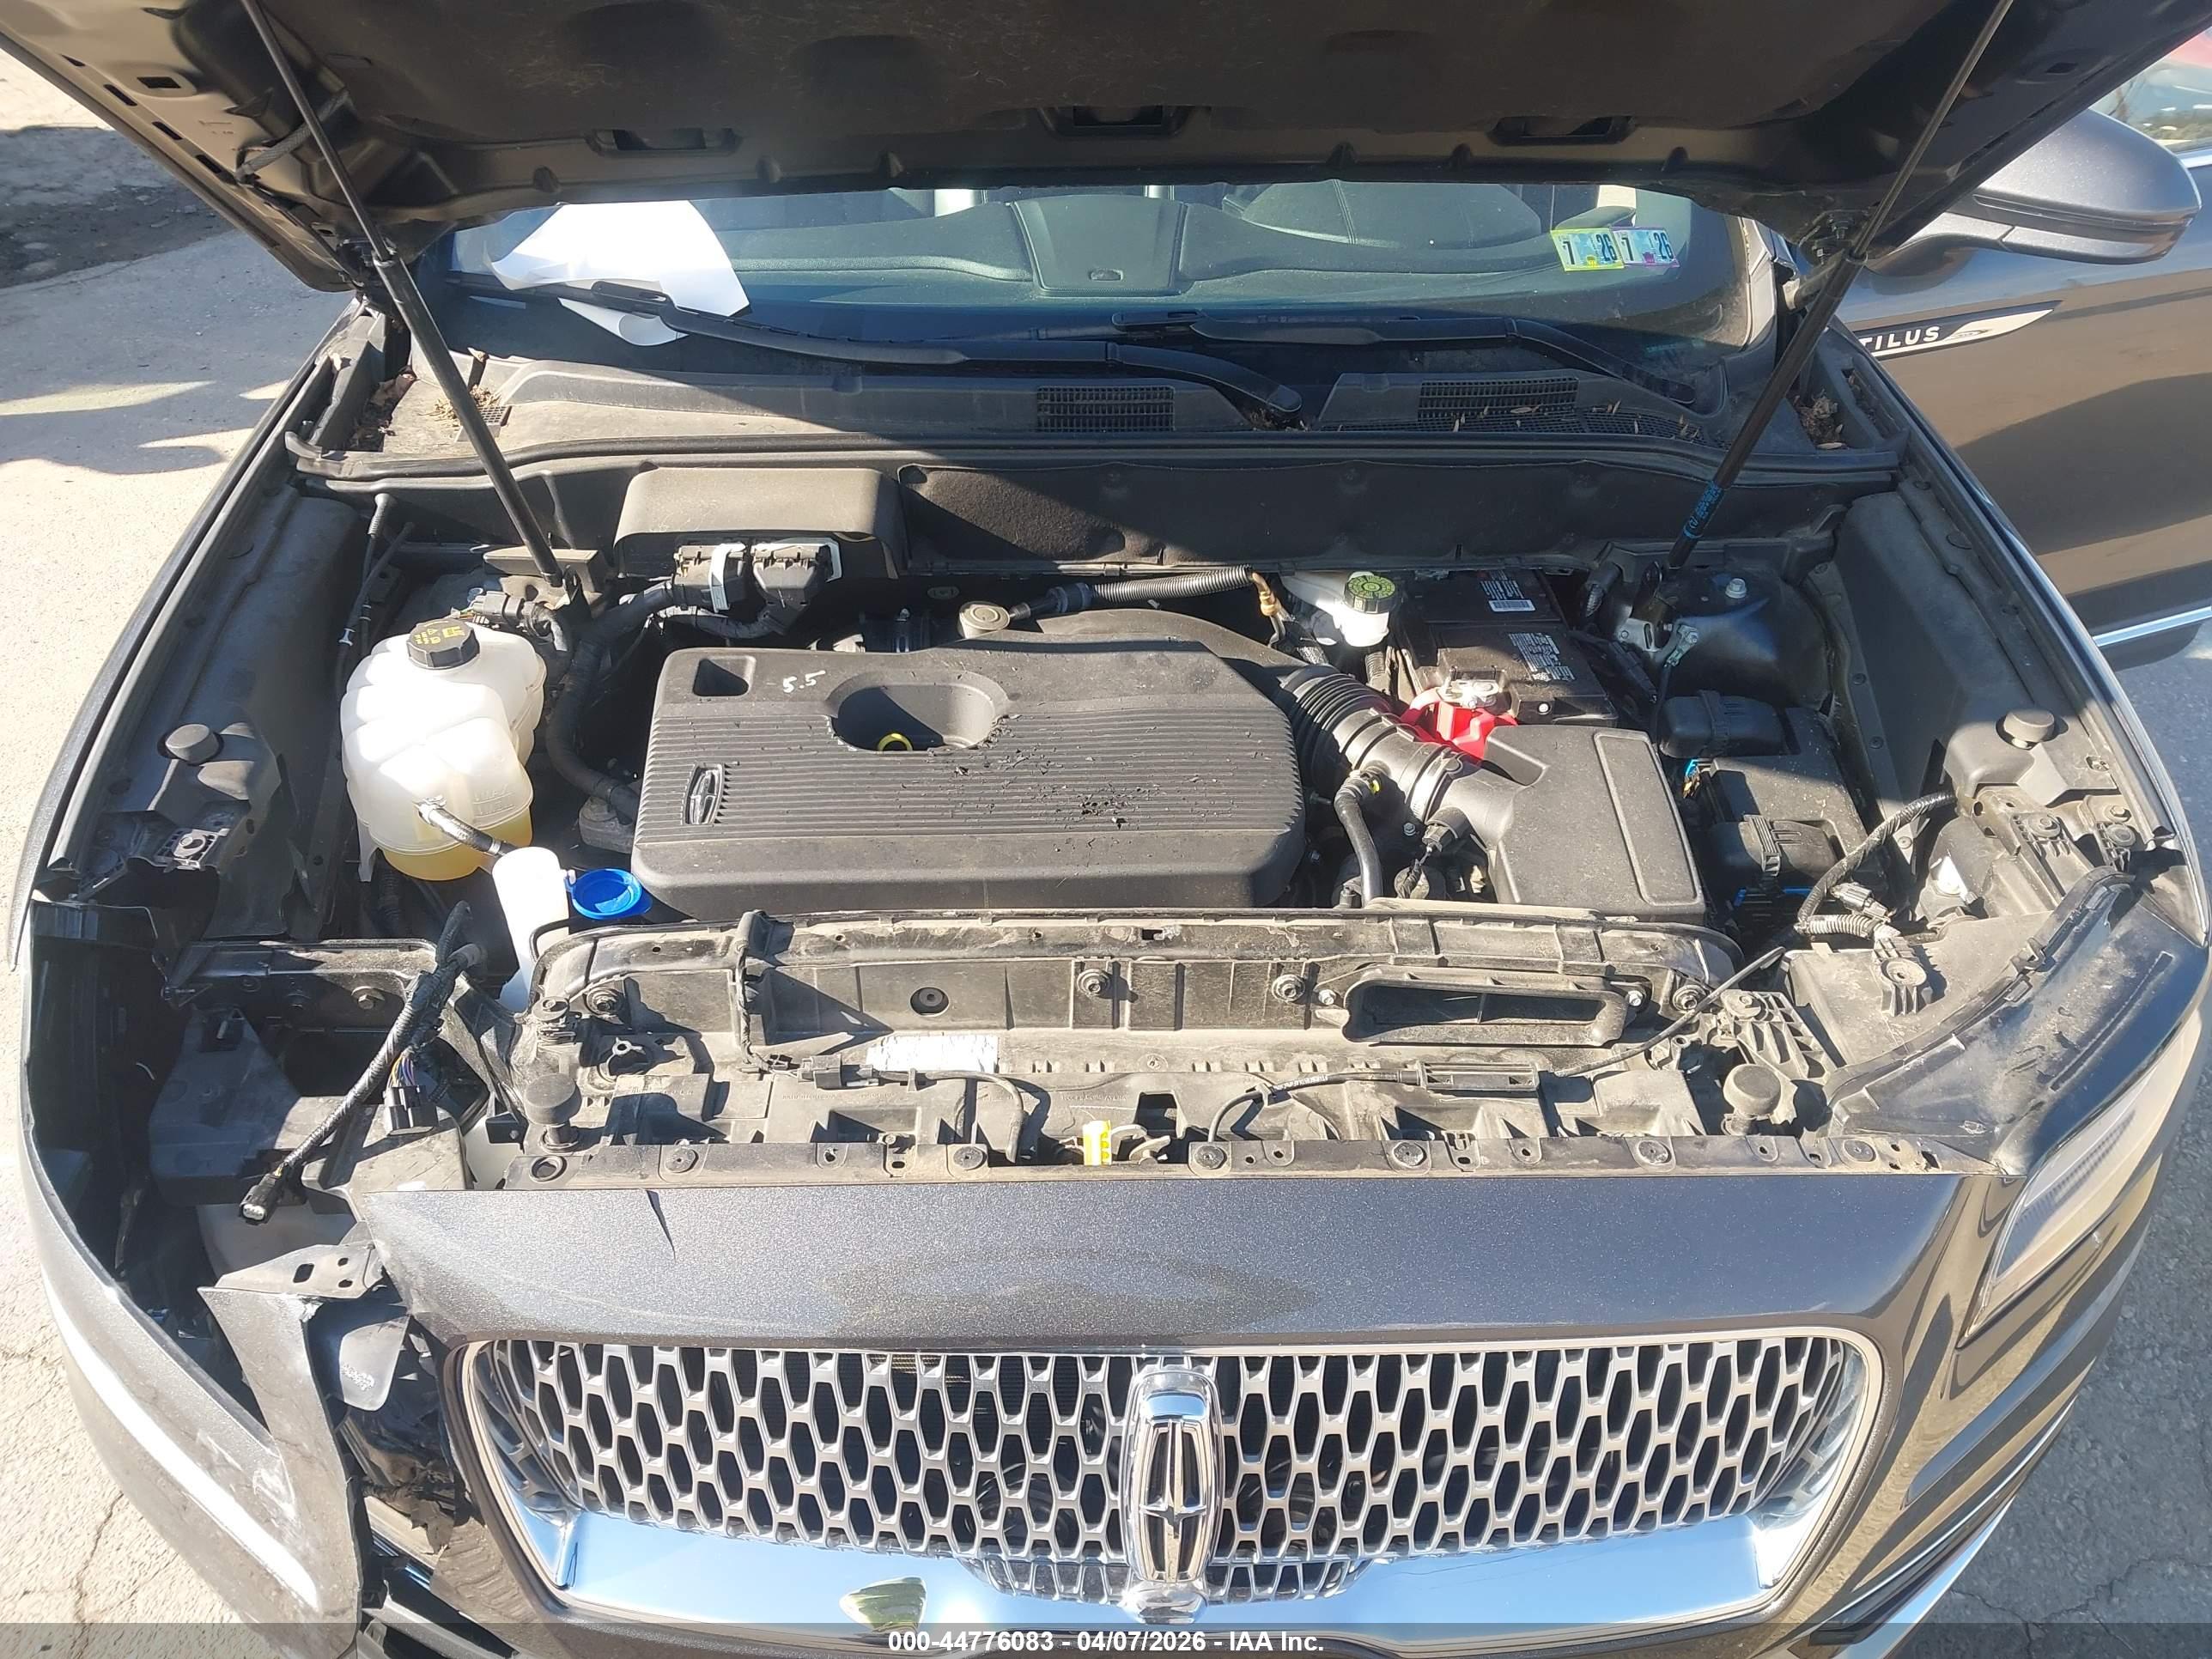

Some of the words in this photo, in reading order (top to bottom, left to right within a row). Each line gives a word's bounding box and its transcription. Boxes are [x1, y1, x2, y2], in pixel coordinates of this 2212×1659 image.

[1563, 240, 1575, 265] 7
[1595, 234, 1618, 262] 26
[1620, 237, 1634, 262] 7
[1654, 232, 1674, 259] 26
